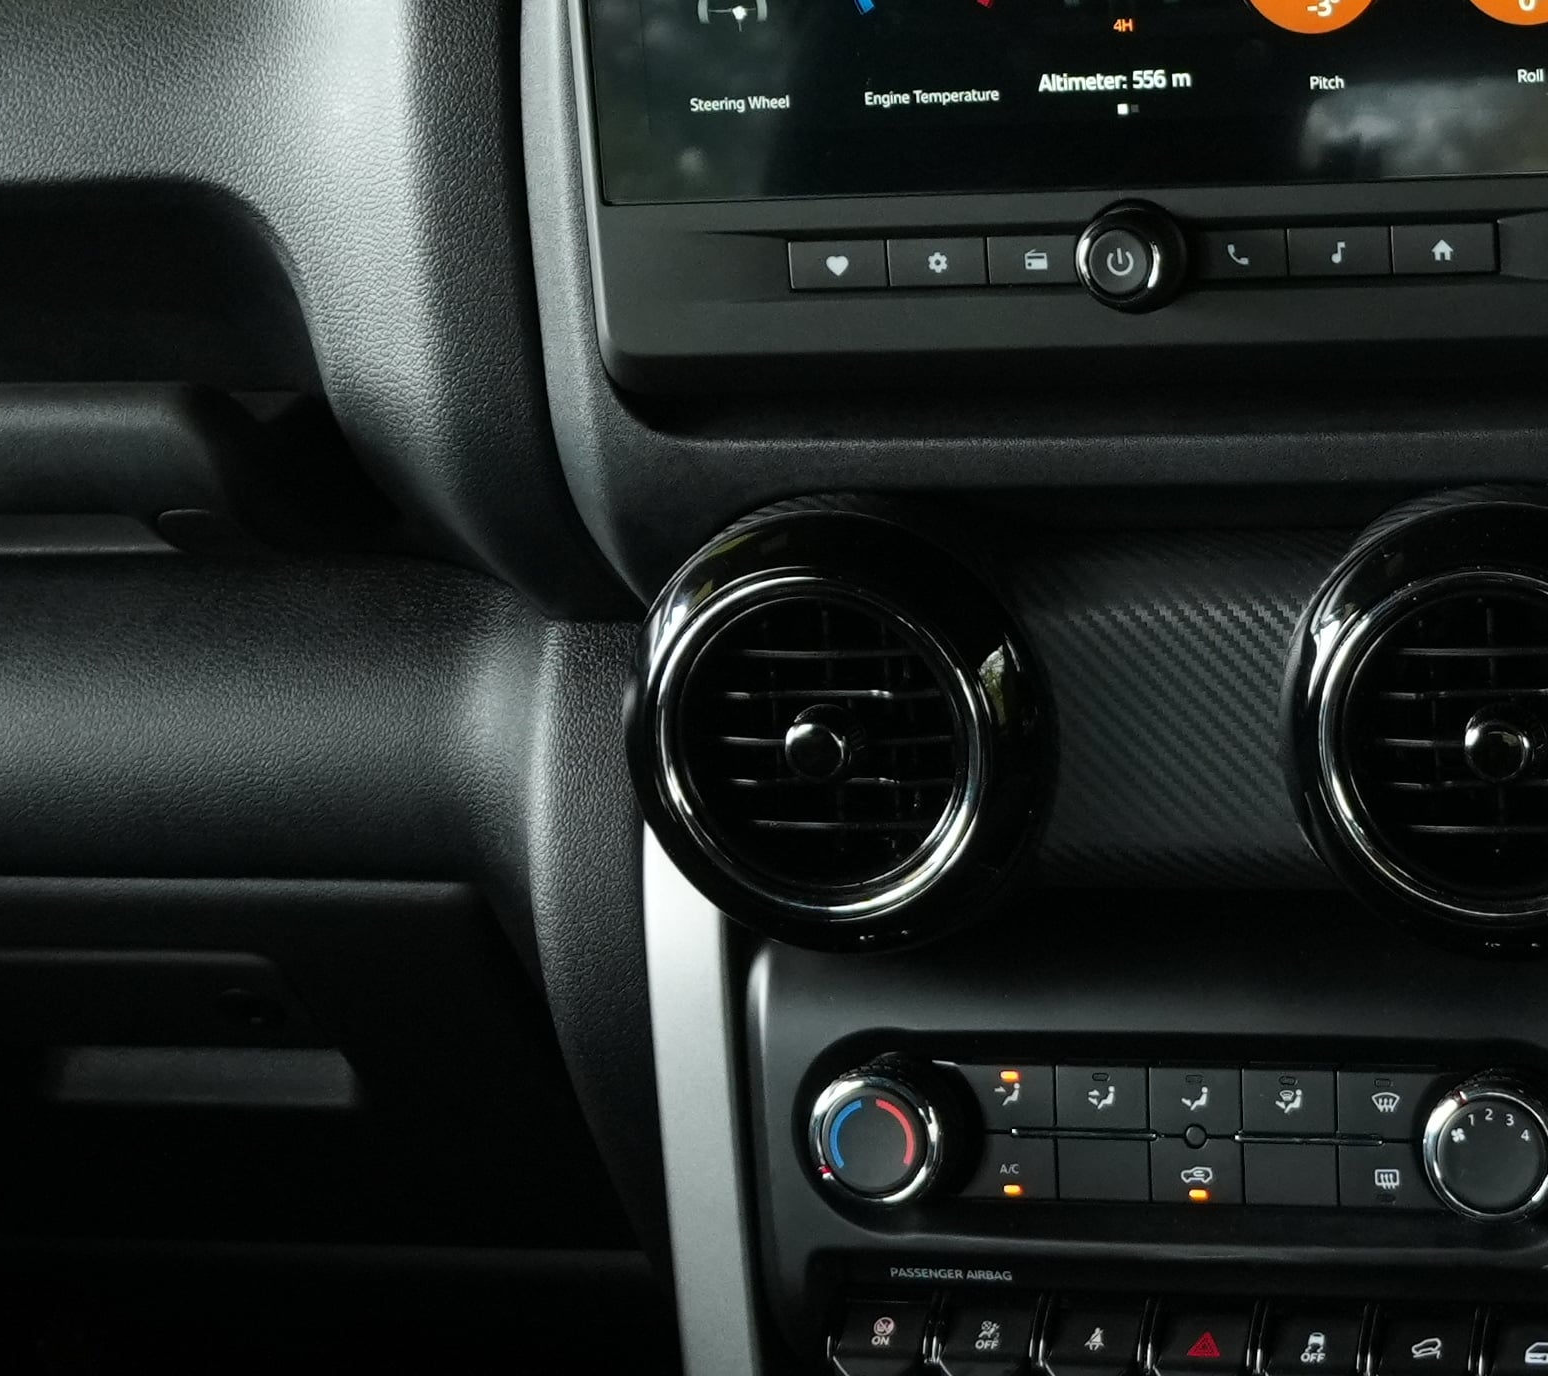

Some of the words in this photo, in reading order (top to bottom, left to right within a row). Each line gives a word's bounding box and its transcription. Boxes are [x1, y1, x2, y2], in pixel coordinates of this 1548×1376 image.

[1113, 18, 1133, 33] 4H
[1038, 73, 1127, 92] Altimeter:
[1131, 70, 1166, 89] 556
[1171, 71, 1191, 88] m
[1309, 75, 1345, 90] Pitch
[1517, 68, 1544, 84] Roll
[690, 96, 746, 113] Steering
[748, 95, 790, 110] Wheel
[864, 90, 910, 108] Engine
[913, 88, 1000, 106] Temperature
[1468, 1114, 1475, 1126] 1
[1484, 1108, 1494, 1121] 2
[1505, 1114, 1515, 1126] 3
[1520, 1129, 1530, 1142] 4
[999, 1163, 1020, 1174] A/C
[890, 1267, 963, 1280] PASSENGER
[966, 1269, 1013, 1282] AIRBAG
[871, 1335, 890, 1346] ON
[974, 1339, 999, 1350] OFF
[1300, 1352, 1326, 1362] OFF
